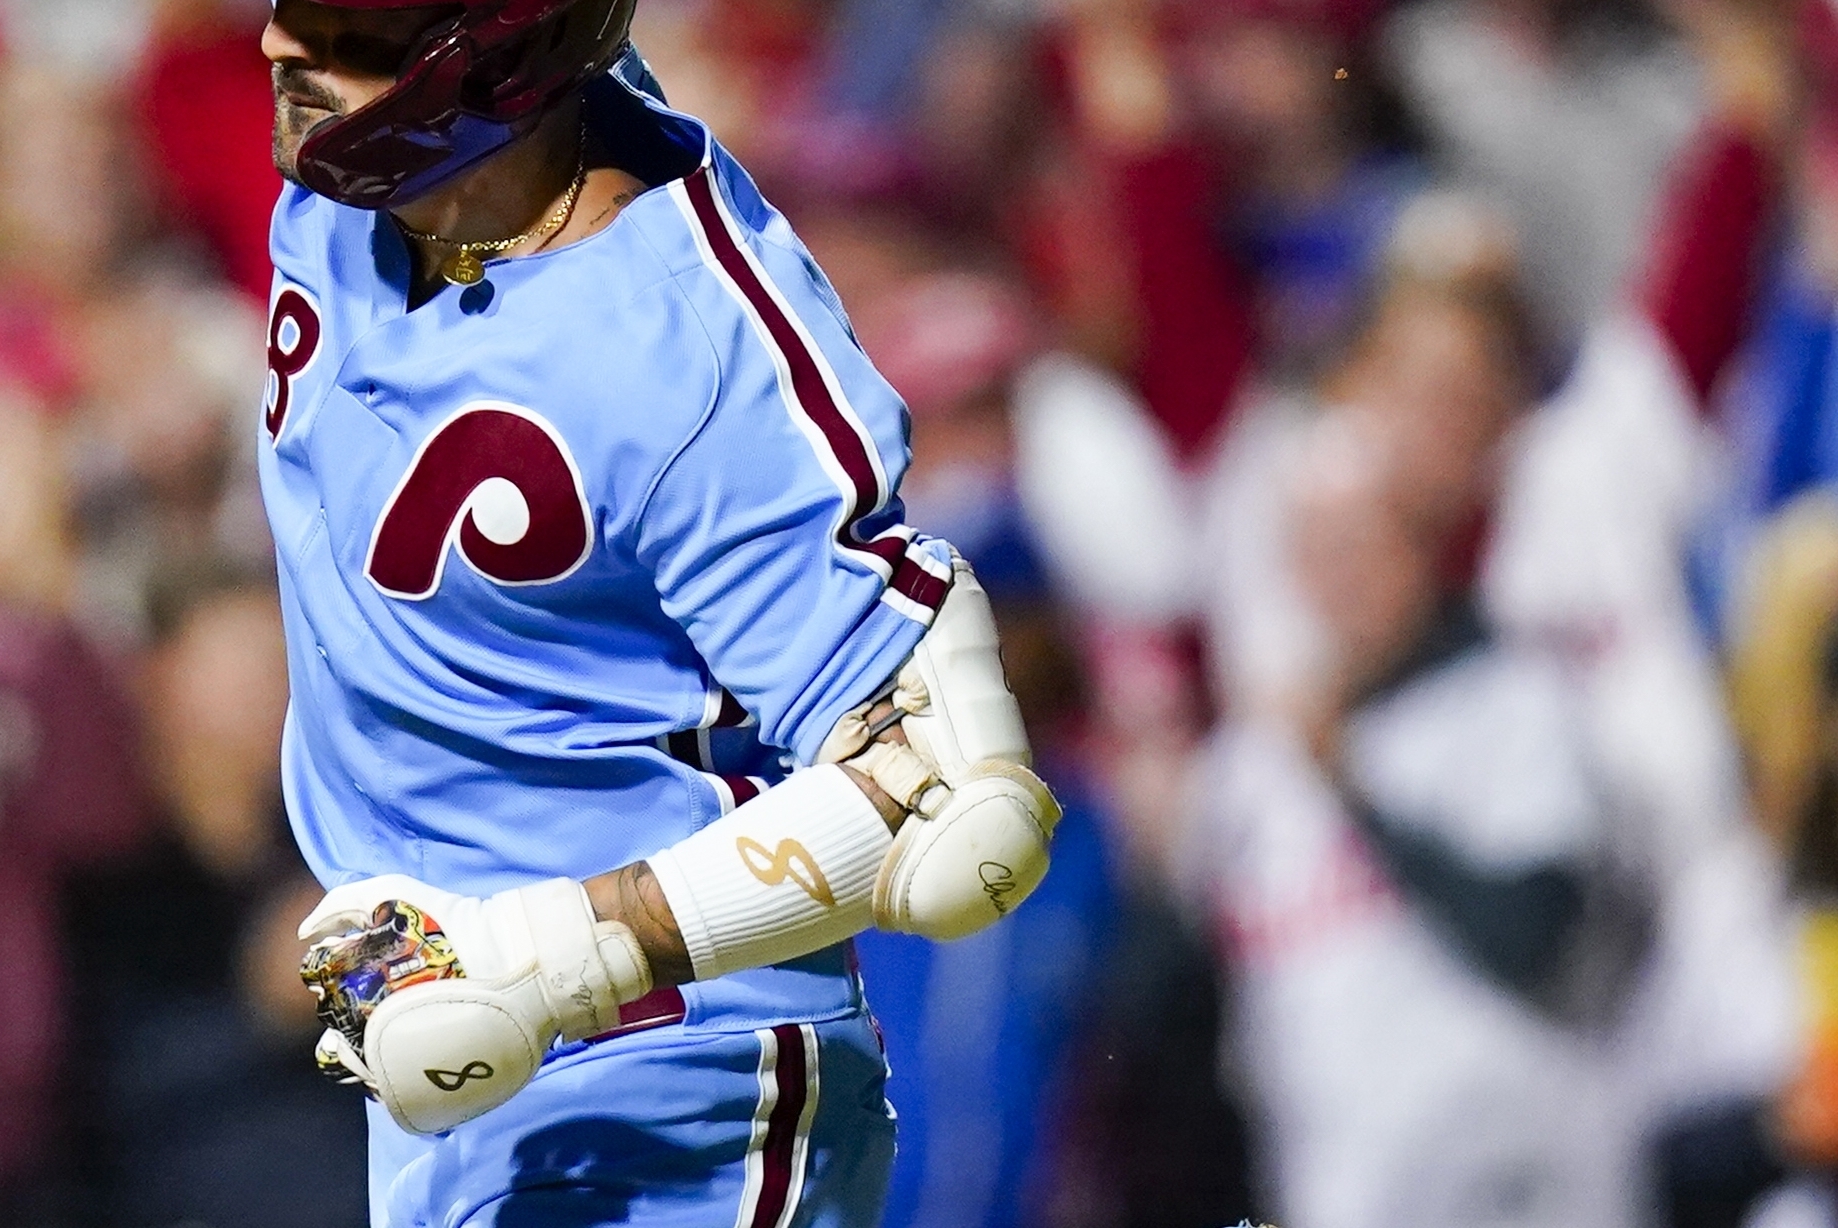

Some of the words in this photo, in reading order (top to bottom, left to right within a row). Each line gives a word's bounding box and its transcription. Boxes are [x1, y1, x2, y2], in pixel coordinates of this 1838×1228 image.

[266, 284, 323, 450] 8
[363, 400, 595, 601] P
[736, 836, 835, 907] 8
[423, 1060, 495, 1092] 8
